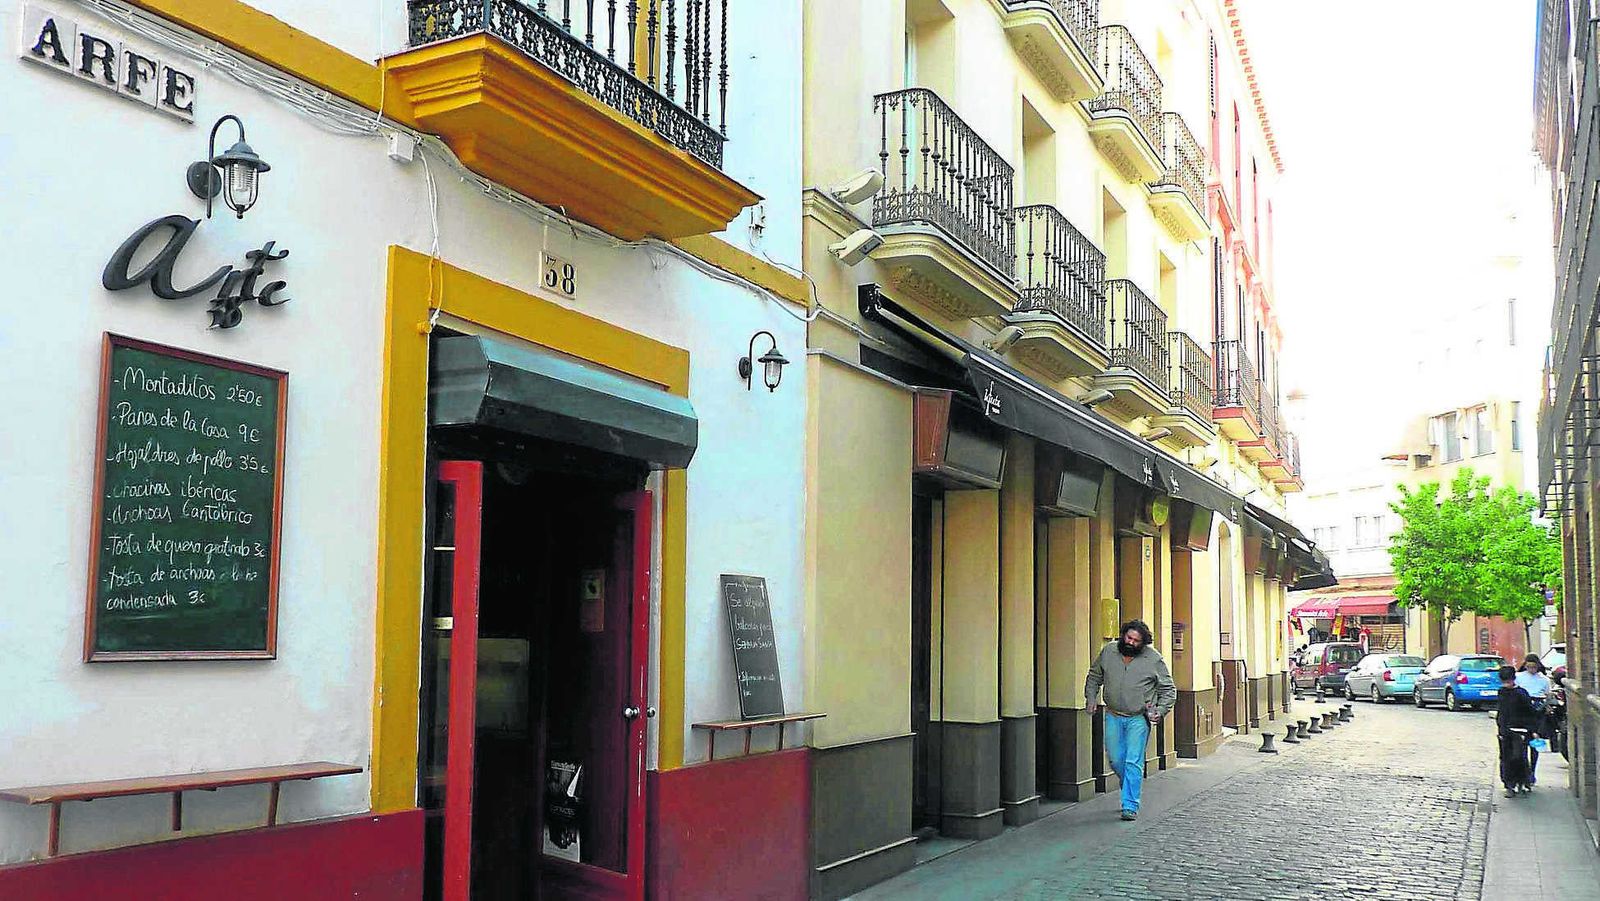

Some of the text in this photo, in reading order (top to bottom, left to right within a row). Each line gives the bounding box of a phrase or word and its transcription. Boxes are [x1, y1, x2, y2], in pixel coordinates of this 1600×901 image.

[32, 18, 195, 115] ARFE
[545, 254, 575, 295] 38
[160, 407, 178, 427] de
[183, 409, 198, 432] la
[201, 418, 230, 439] Casa
[185, 448, 202, 464] de
[203, 450, 233, 475] pollo
[180, 474, 237, 503] ibéricas
[146, 532, 162, 555] de
[164, 539, 201, 565] queso
[151, 564, 164, 582] de
[169, 562, 216, 581] anchoas
[106, 589, 179, 611] condensada
